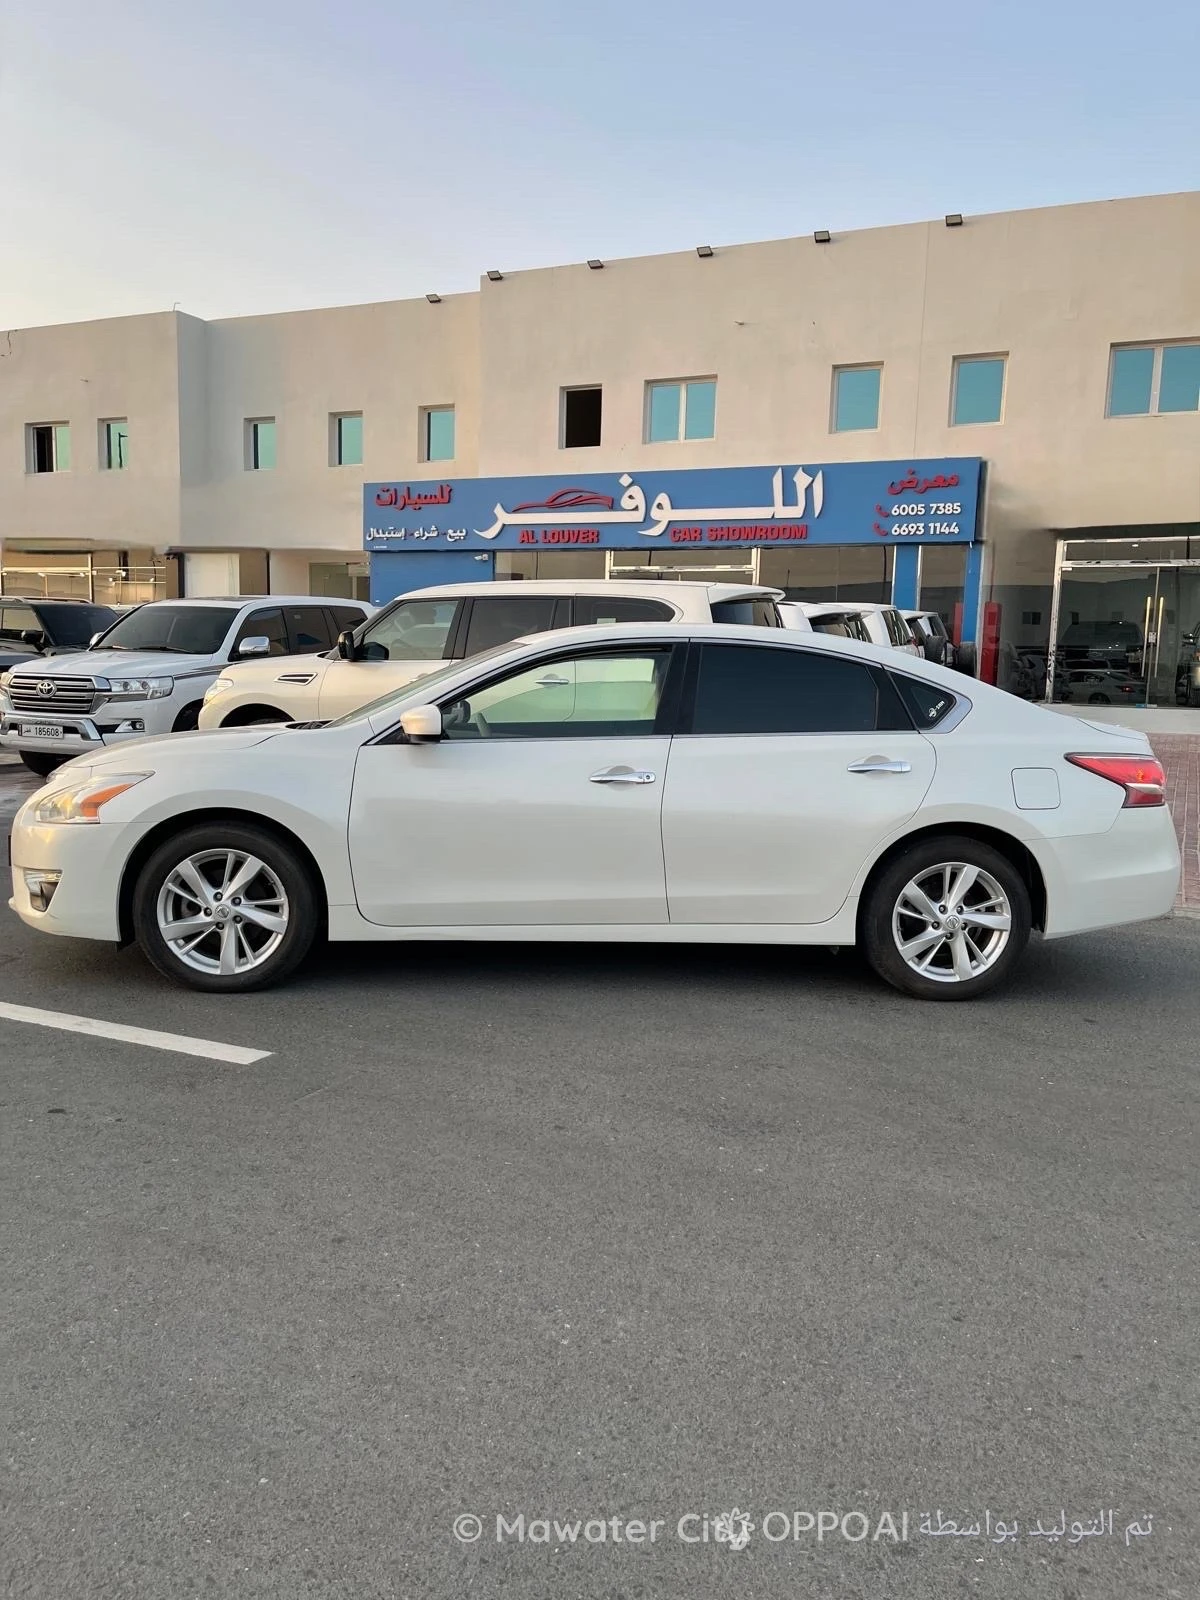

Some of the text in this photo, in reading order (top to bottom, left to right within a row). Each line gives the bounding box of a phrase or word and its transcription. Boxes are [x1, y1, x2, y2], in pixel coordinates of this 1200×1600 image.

[887, 469, 959, 495] معرض
[375, 483, 453, 511] للسيارات
[891, 502, 961, 517] 6005 7385
[414, 524, 439, 540] شراء
[446, 528, 467, 542] بيع
[519, 529, 600, 544] AL LOUVER
[669, 523, 808, 543] CAR SHOWROOM
[891, 522, 960, 536] 6693 1144
[35, 727, 59, 737] 185608
